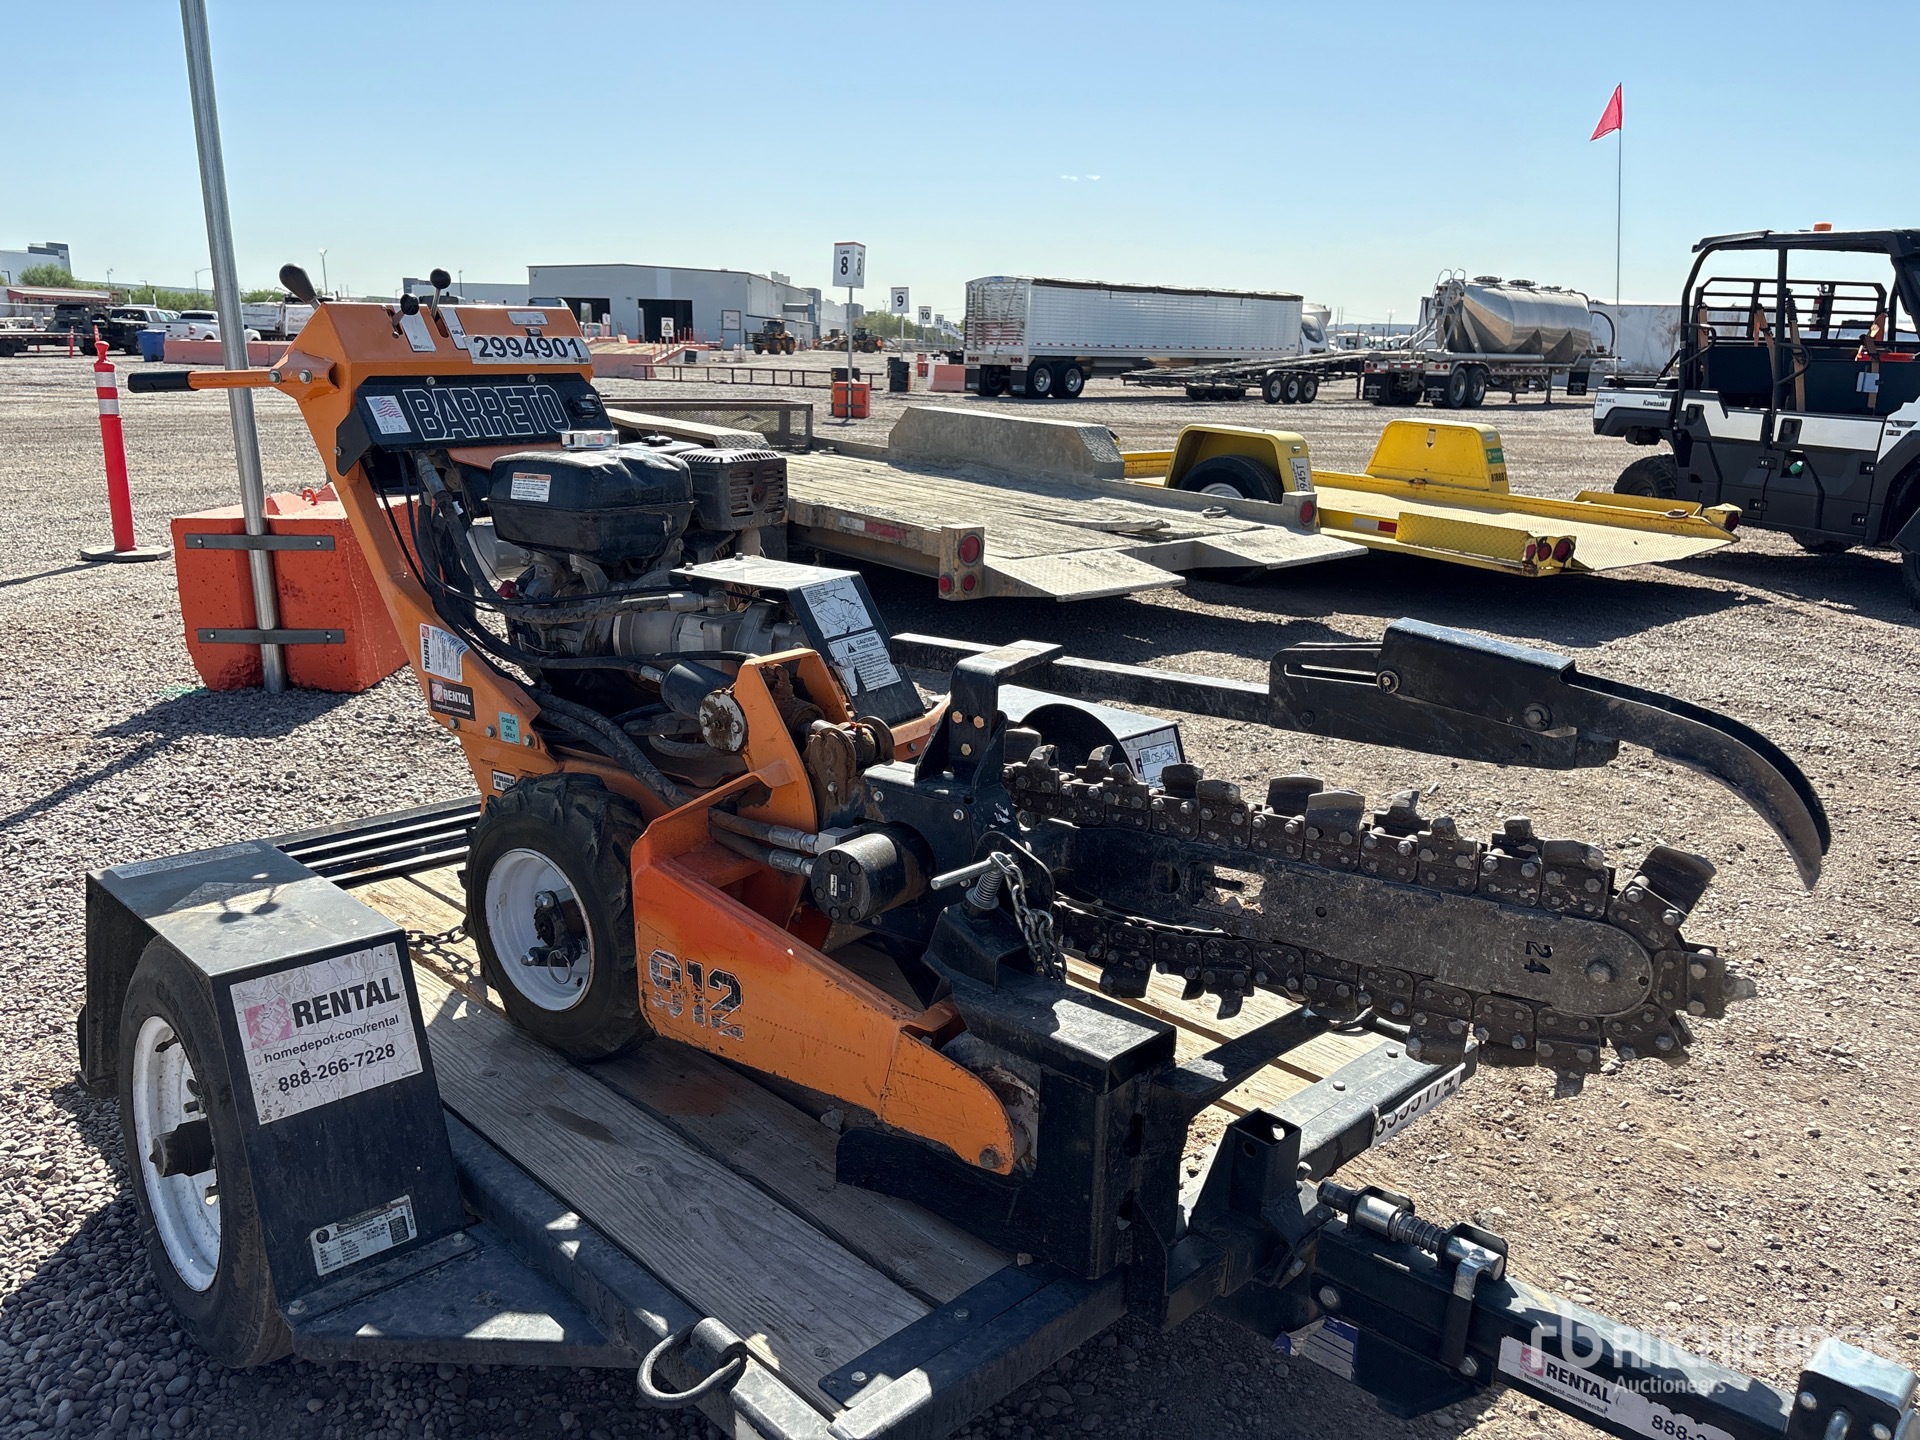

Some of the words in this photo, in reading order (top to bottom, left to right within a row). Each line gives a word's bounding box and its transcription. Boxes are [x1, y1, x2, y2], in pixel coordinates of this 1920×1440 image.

[841, 256, 848, 275] 8
[897, 295, 903, 306] 9
[921, 312, 929, 320] 10
[474, 336, 581, 358] 2994901
[402, 385, 571, 441] BARRETO
[856, 636, 876, 646] CAUTION
[443, 689, 471, 705] RENTAL
[502, 717, 516, 725] CHECK
[1524, 941, 1552, 974] 24
[292, 977, 400, 1028] RENTAL
[649, 949, 745, 1041] 912
[264, 1014, 399, 1063] homedepot.com/rental
[278, 1043, 396, 1092] 888-266-7228
[1546, 1362, 1611, 1404] RENTAL
